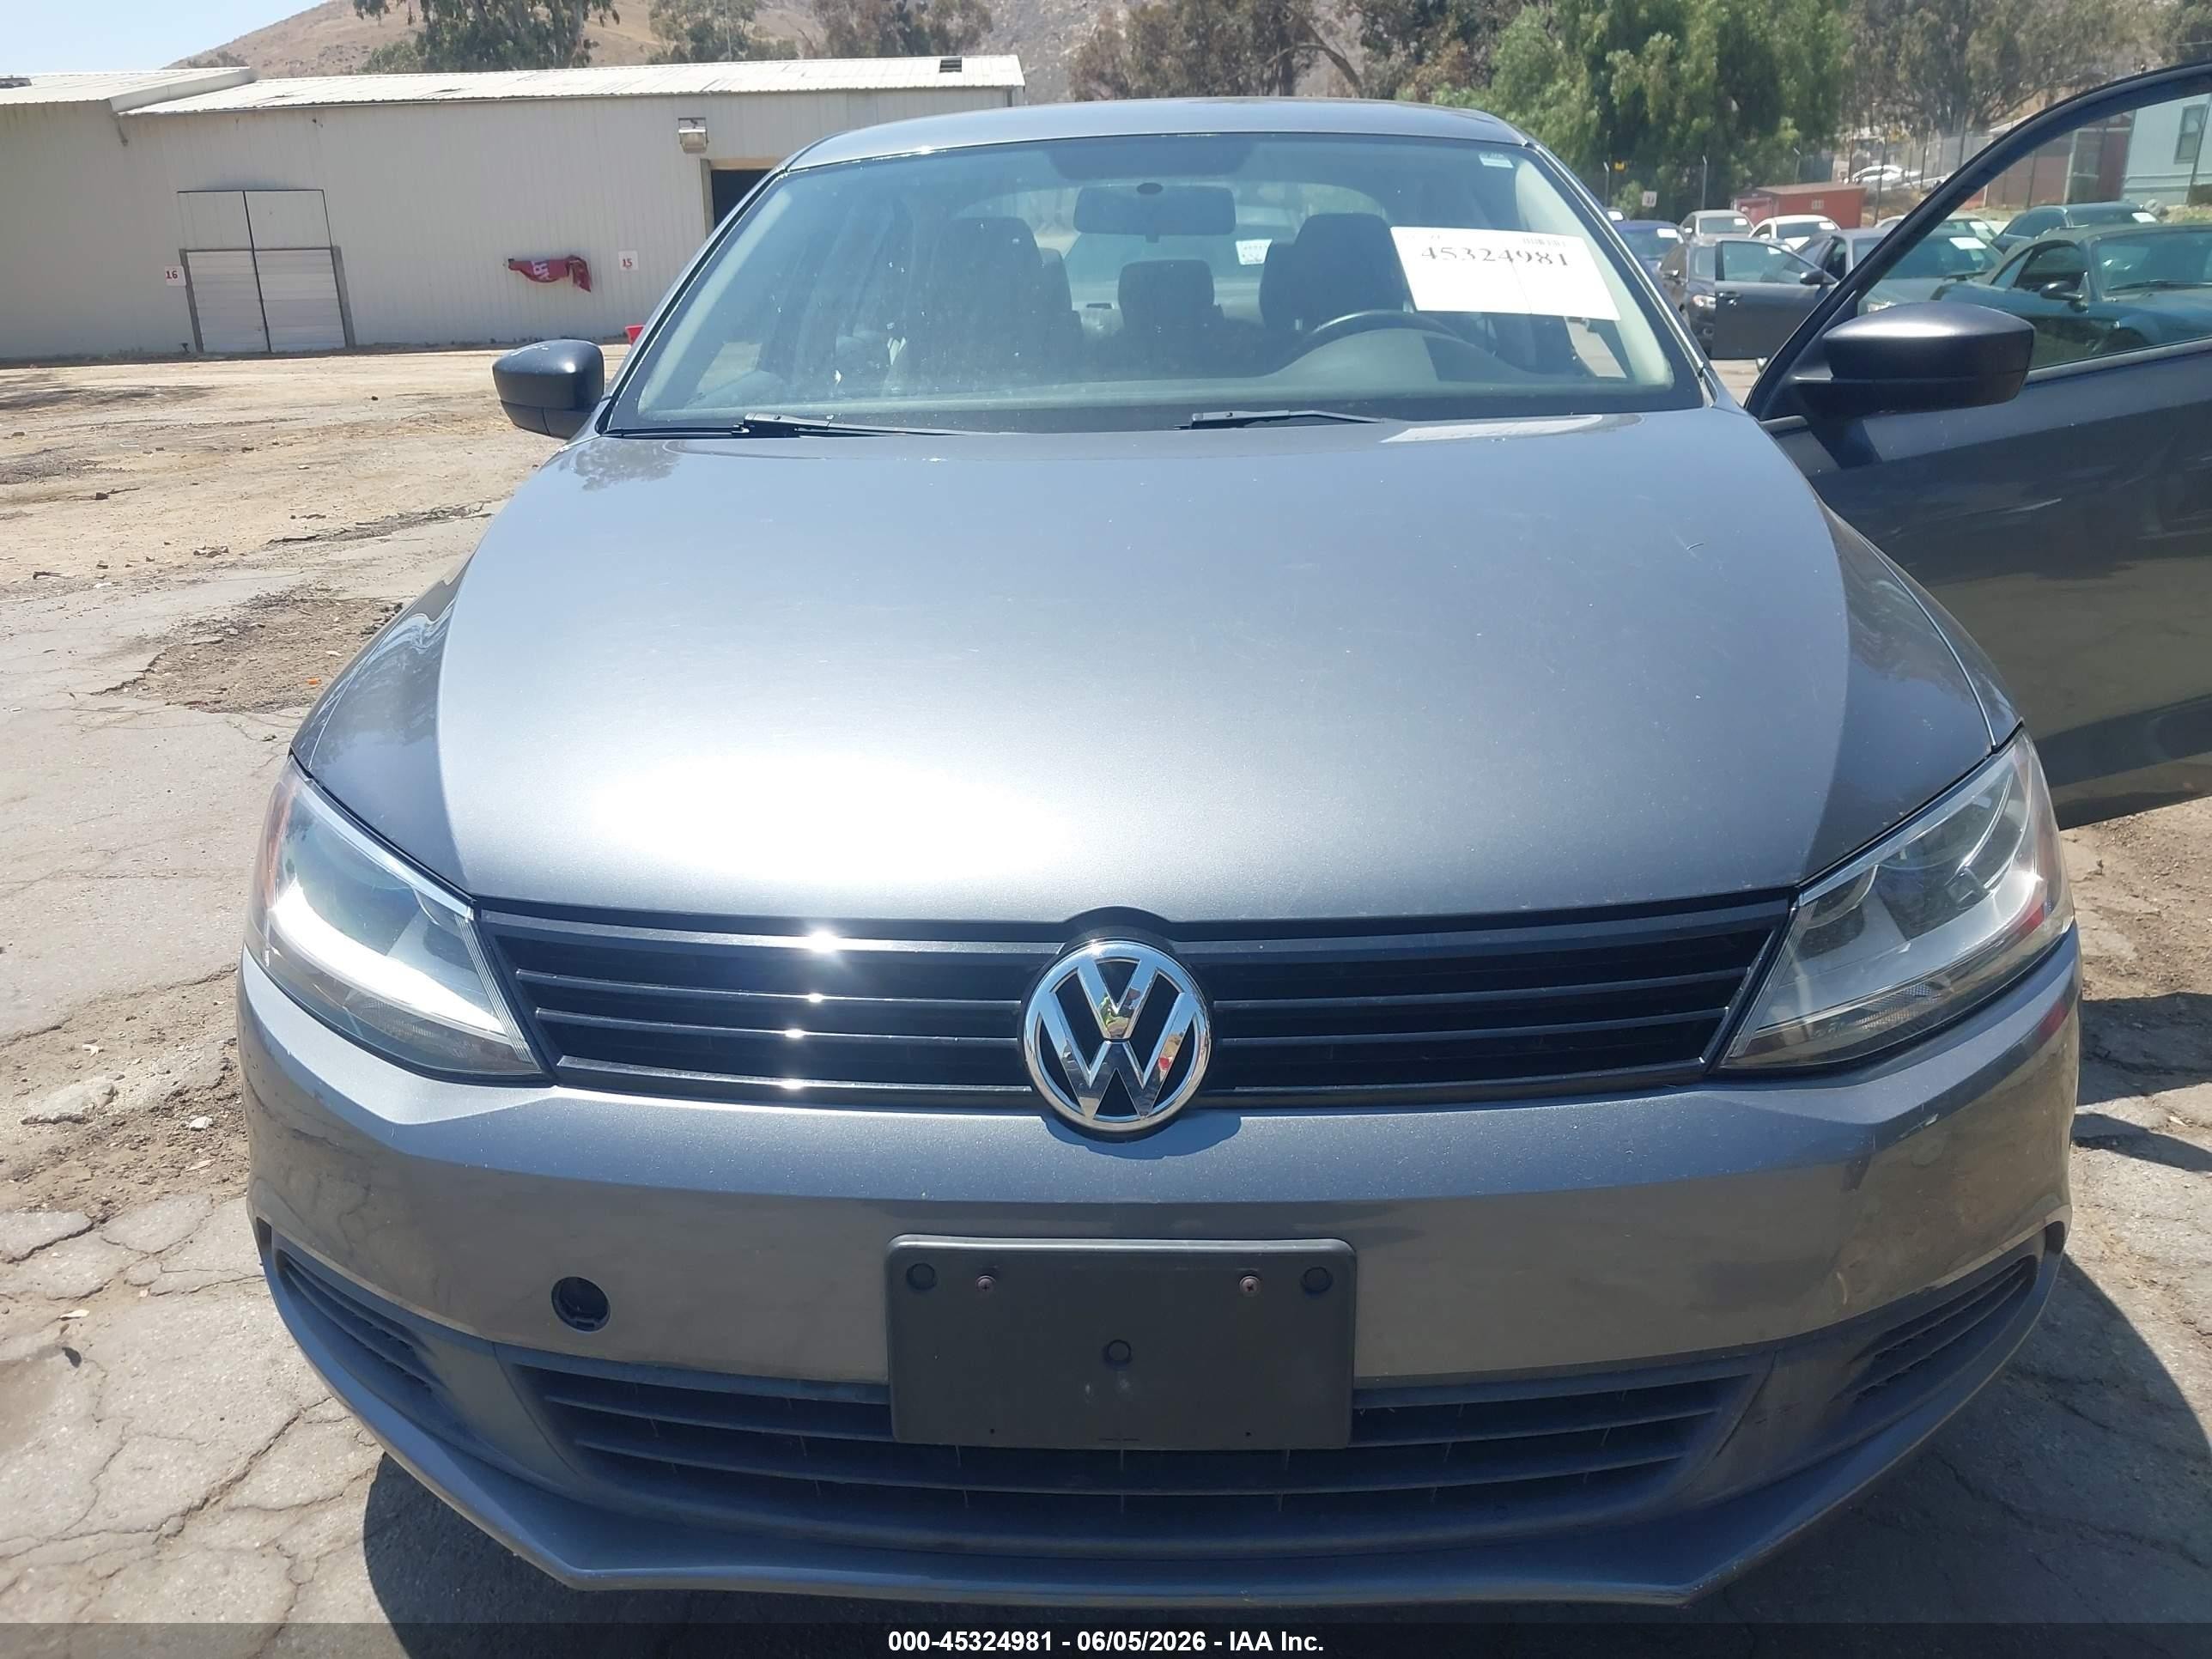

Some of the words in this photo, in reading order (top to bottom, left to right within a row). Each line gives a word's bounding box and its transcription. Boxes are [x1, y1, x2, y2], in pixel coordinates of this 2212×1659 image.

[622, 258, 632, 269] 15
[1421, 246, 1568, 266] 45324981
[166, 270, 179, 279] 16
[1037, 957, 1199, 1120] VW
